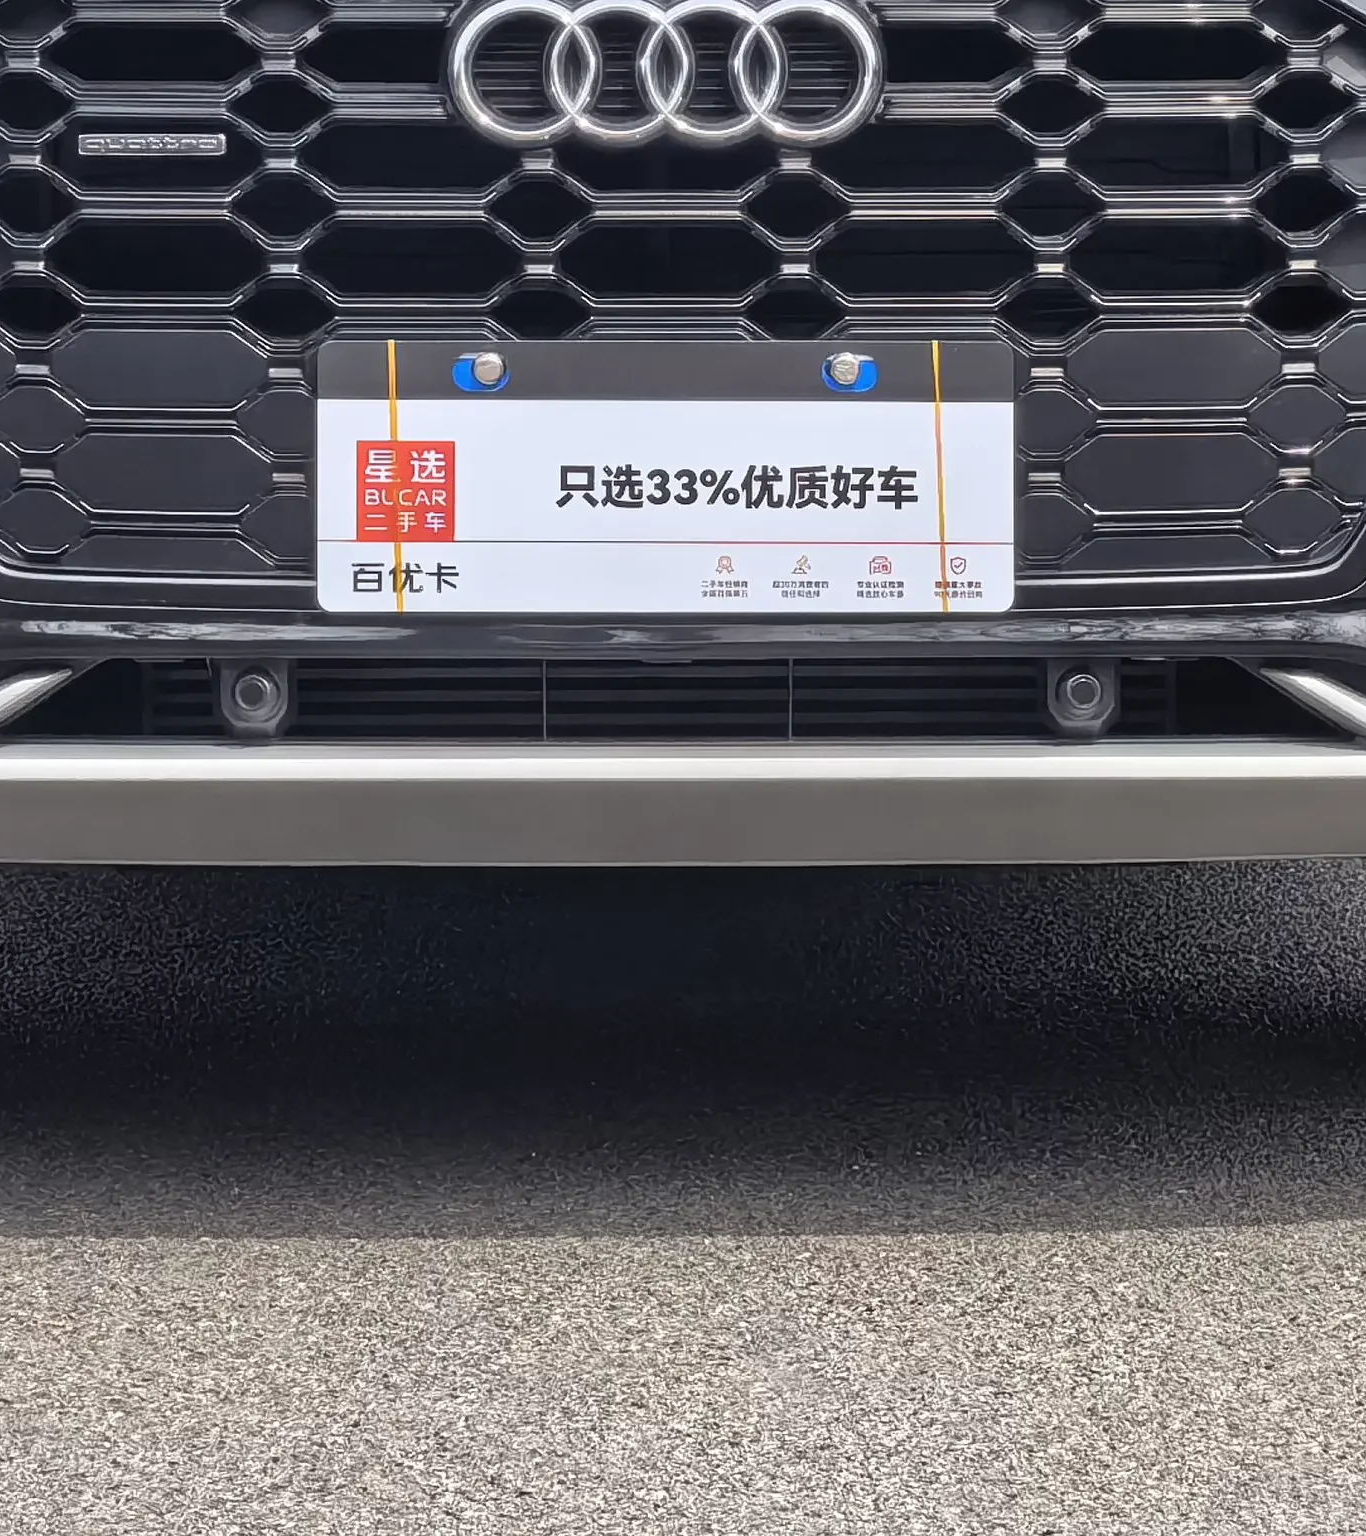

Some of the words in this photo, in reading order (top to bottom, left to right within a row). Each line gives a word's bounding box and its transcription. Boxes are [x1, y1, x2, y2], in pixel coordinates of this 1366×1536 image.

[365, 449, 447, 483] 星选
[556, 464, 919, 509] 只选33%优质好车
[364, 511, 447, 533] 二手车
[352, 562, 459, 593] 百优卡
